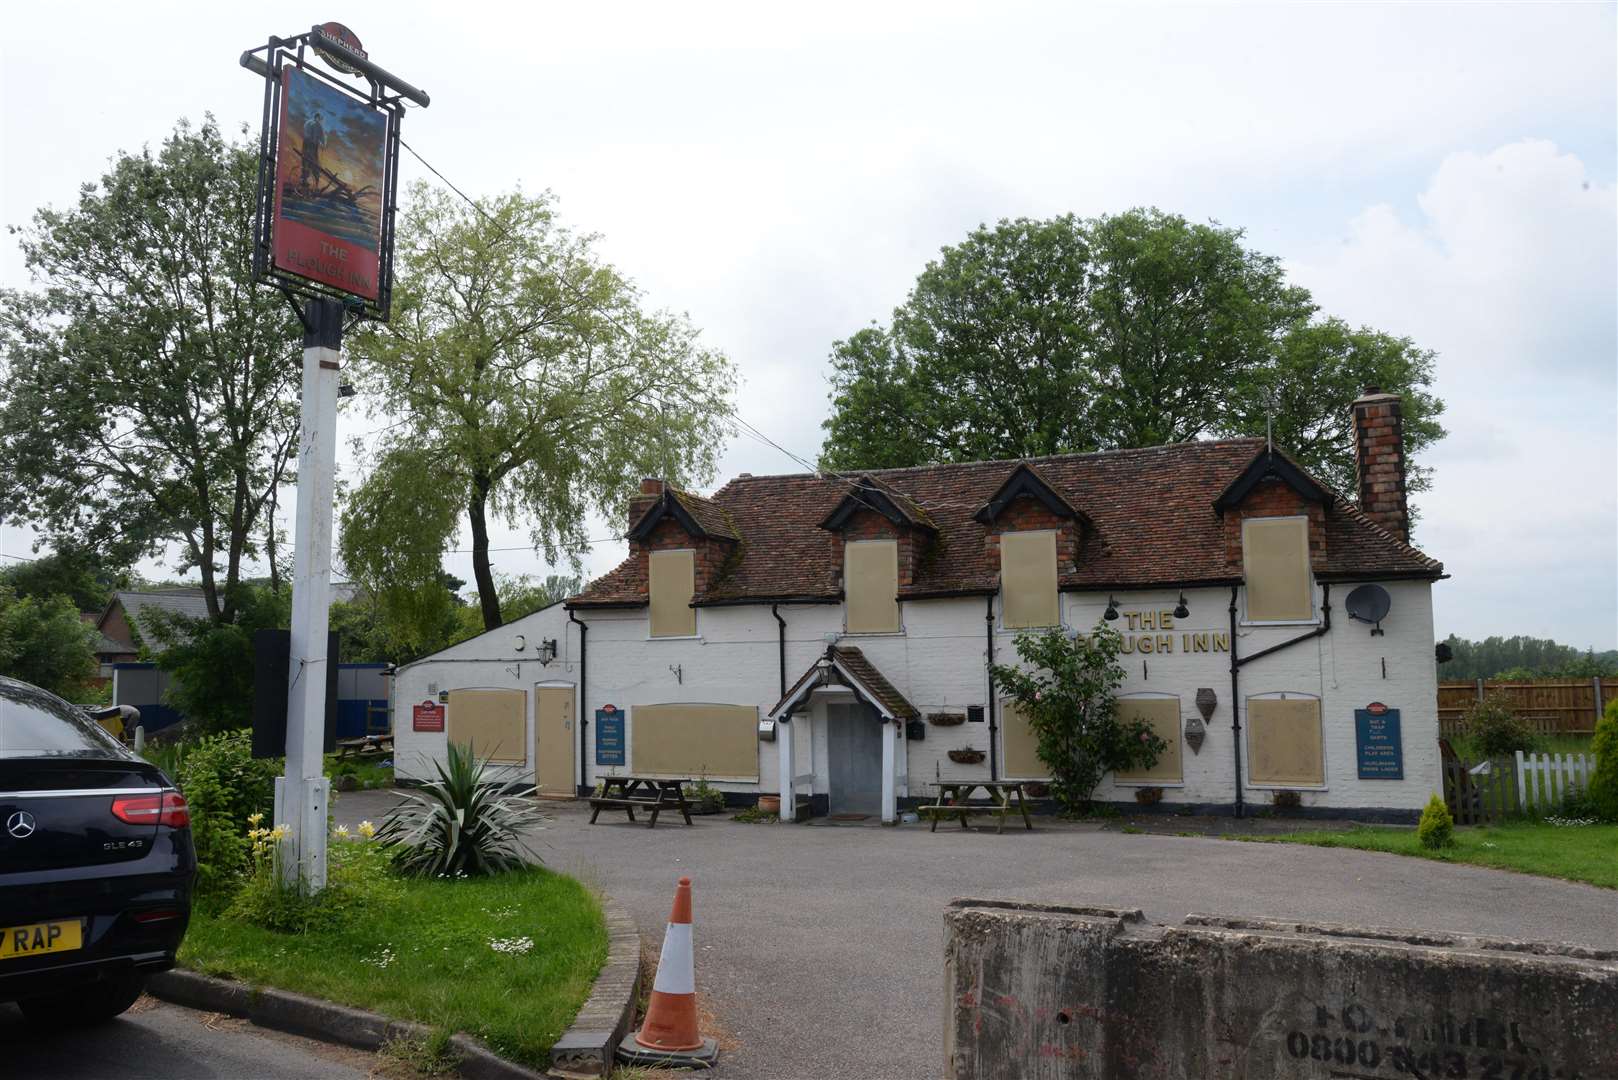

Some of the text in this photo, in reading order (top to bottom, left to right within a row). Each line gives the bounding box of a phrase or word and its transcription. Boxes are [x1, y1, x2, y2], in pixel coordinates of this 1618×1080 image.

[319, 240, 350, 262] THE
[286, 247, 373, 289] PLOUGH INN
[1123, 610, 1174, 631] THE
[1182, 631, 1230, 653] INN
[103, 841, 126, 851] GLE
[14, 925, 62, 953] RAP
[1286, 1031, 1379, 1068] 0800
